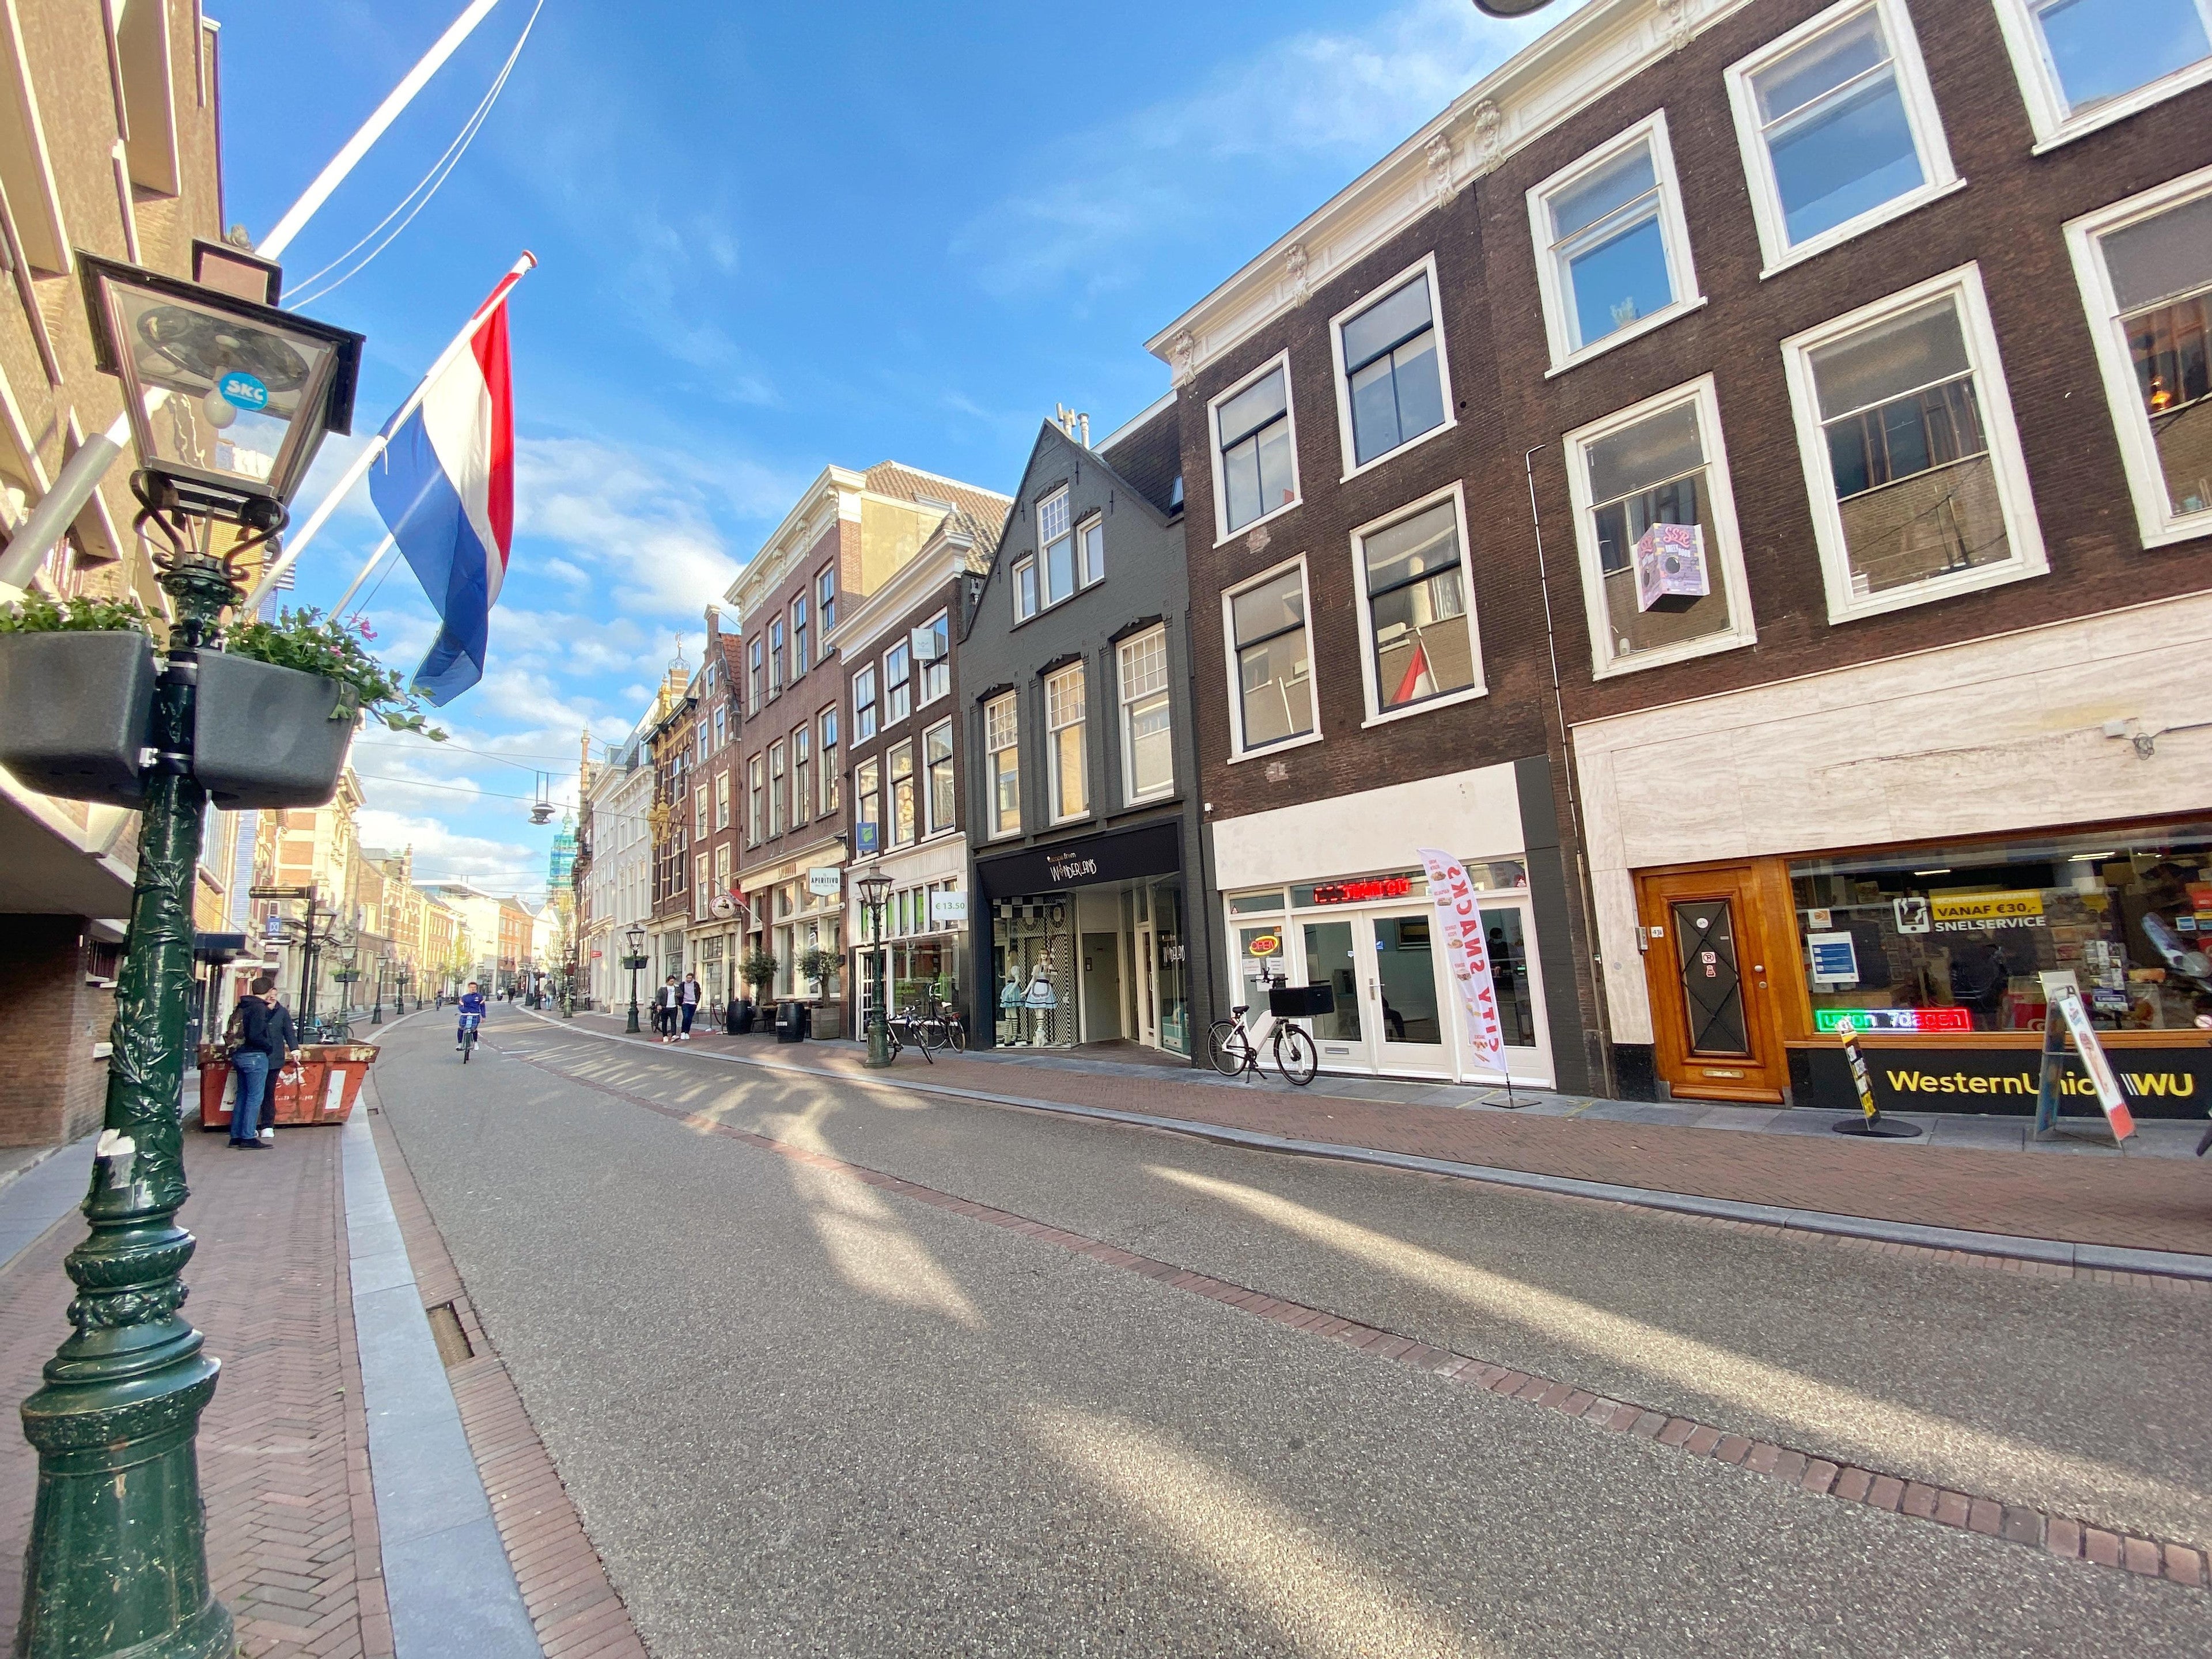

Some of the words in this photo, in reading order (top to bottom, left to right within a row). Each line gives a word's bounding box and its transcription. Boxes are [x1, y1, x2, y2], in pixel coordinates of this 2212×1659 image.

[226, 380, 264, 401] SKC
[1663, 526, 1690, 548] SSR
[1050, 859, 1097, 882] WONDERLAND
[1937, 905, 1991, 916] VANAF
[1996, 903, 2037, 914] €30,-
[1935, 916, 2046, 932] SNELSERVICE
[1251, 941, 1274, 950] OPEN
[1886, 1070, 2097, 1096] WesternUio
[2133, 1073, 2194, 1097] WU
